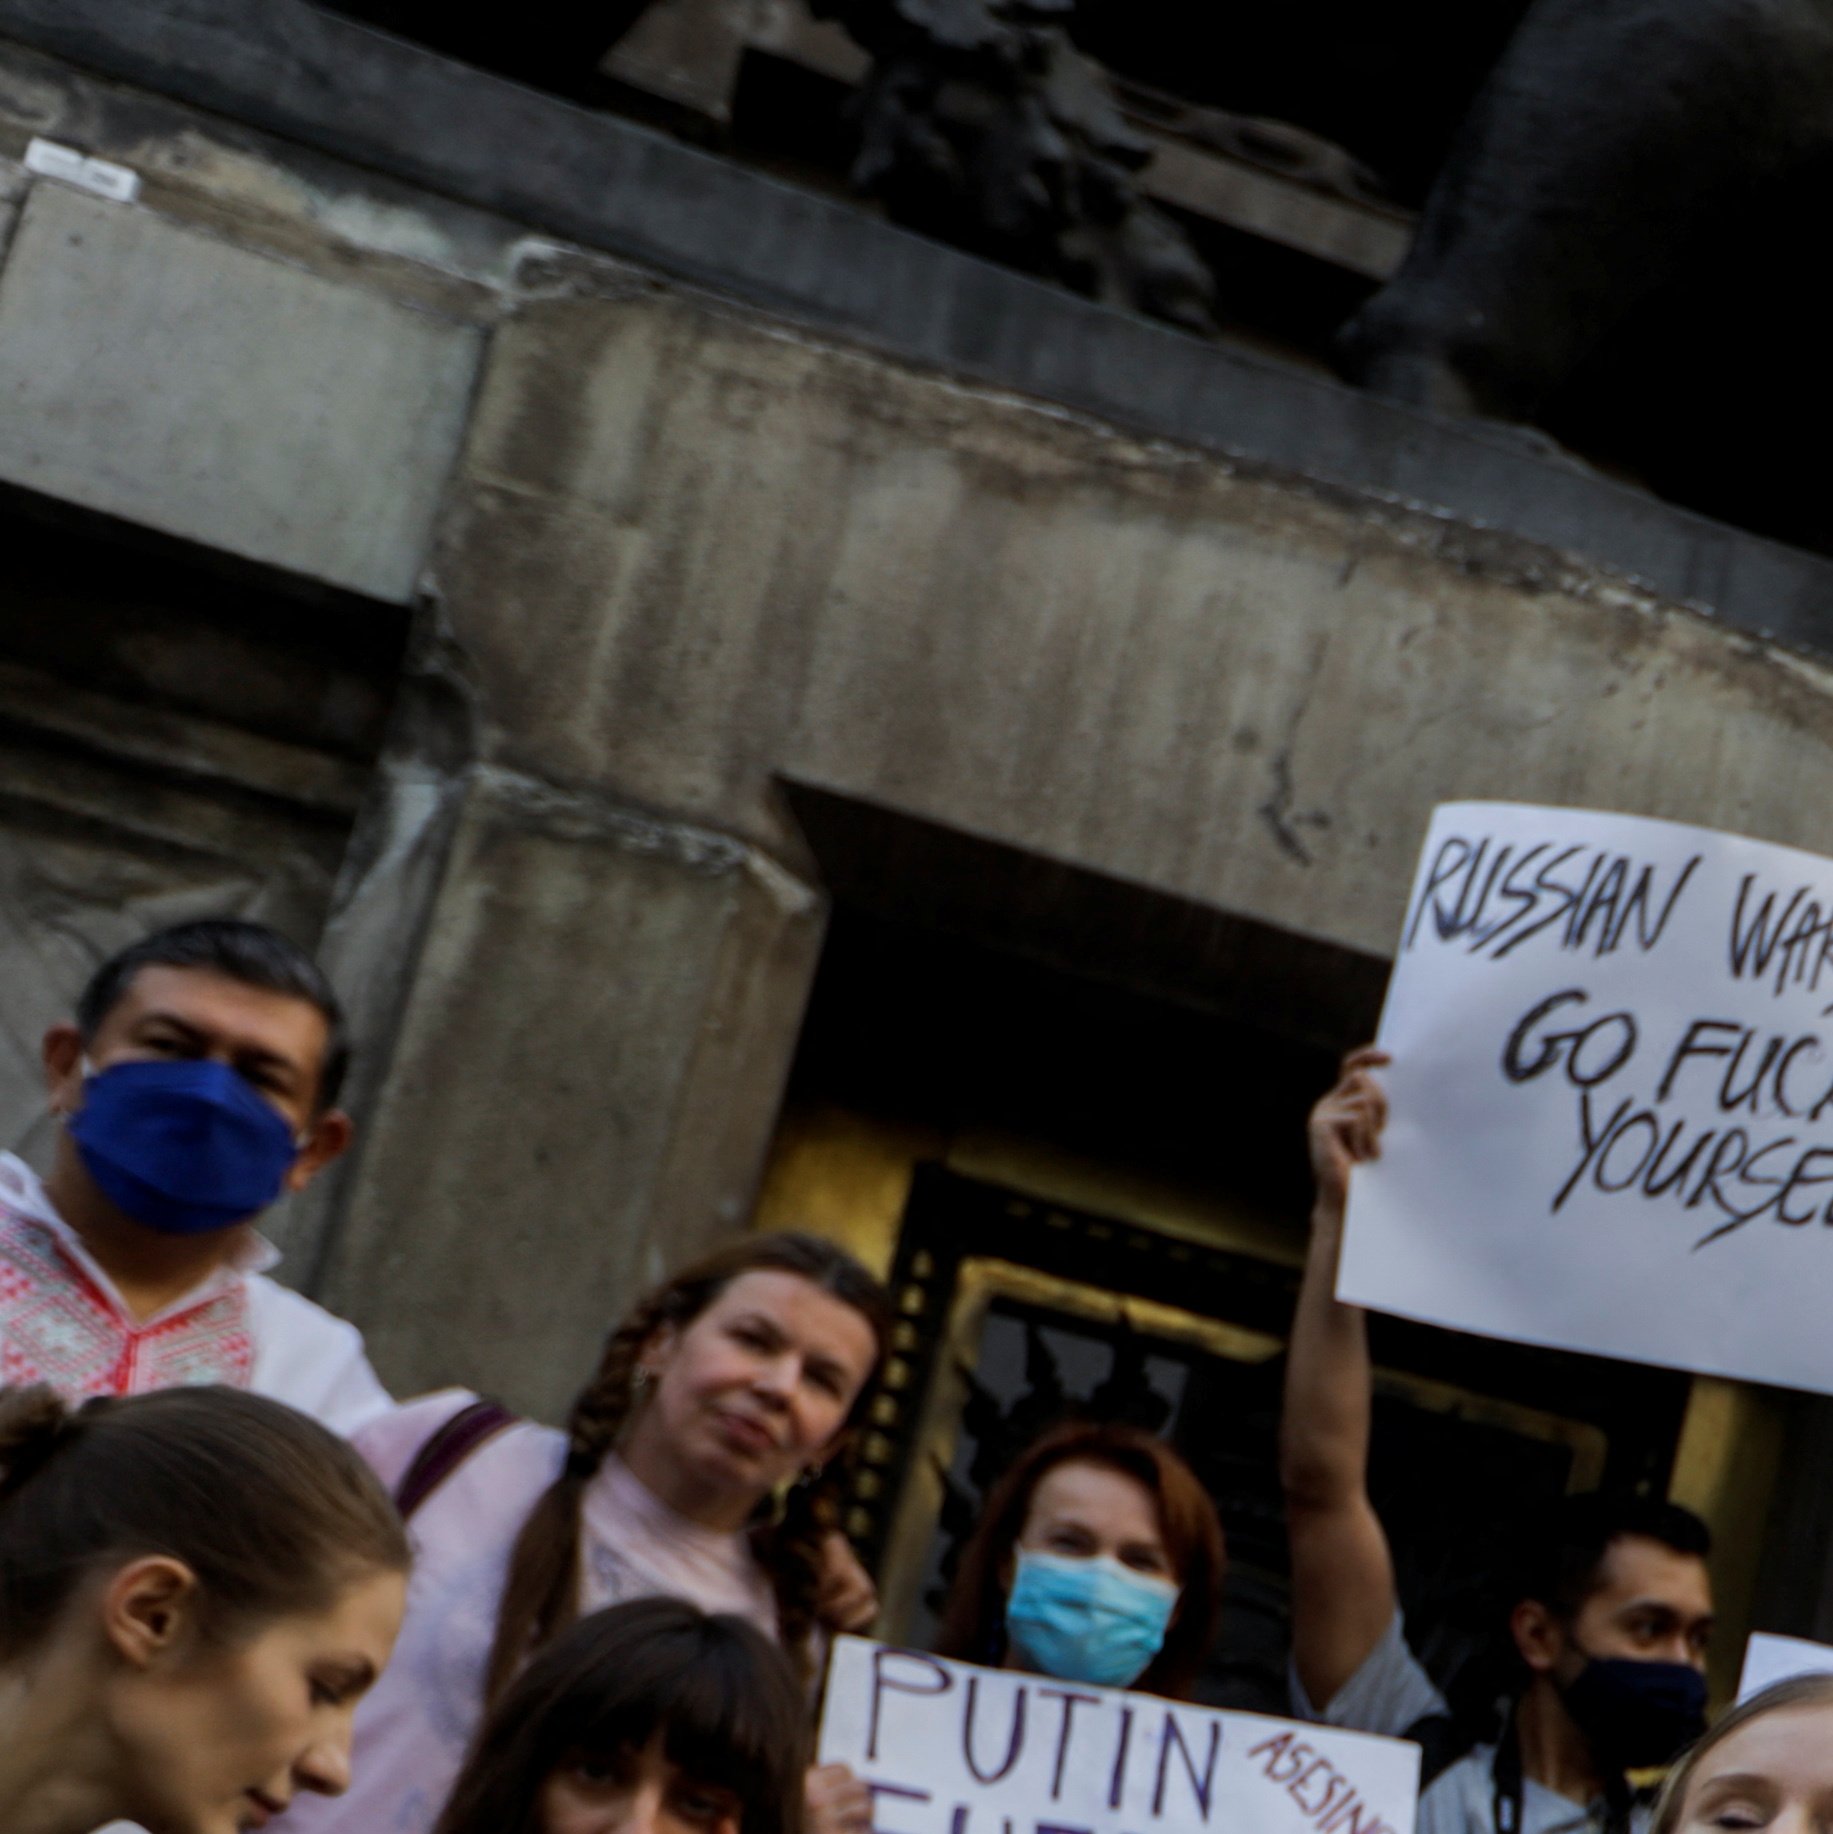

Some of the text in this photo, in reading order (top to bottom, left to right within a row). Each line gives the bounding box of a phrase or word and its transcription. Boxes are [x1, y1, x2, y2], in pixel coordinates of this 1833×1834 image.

[1405, 836, 1703, 960] RUSSIAN
[1502, 987, 1638, 1088] GO
[865, 1645, 1222, 1822] PUTIN
